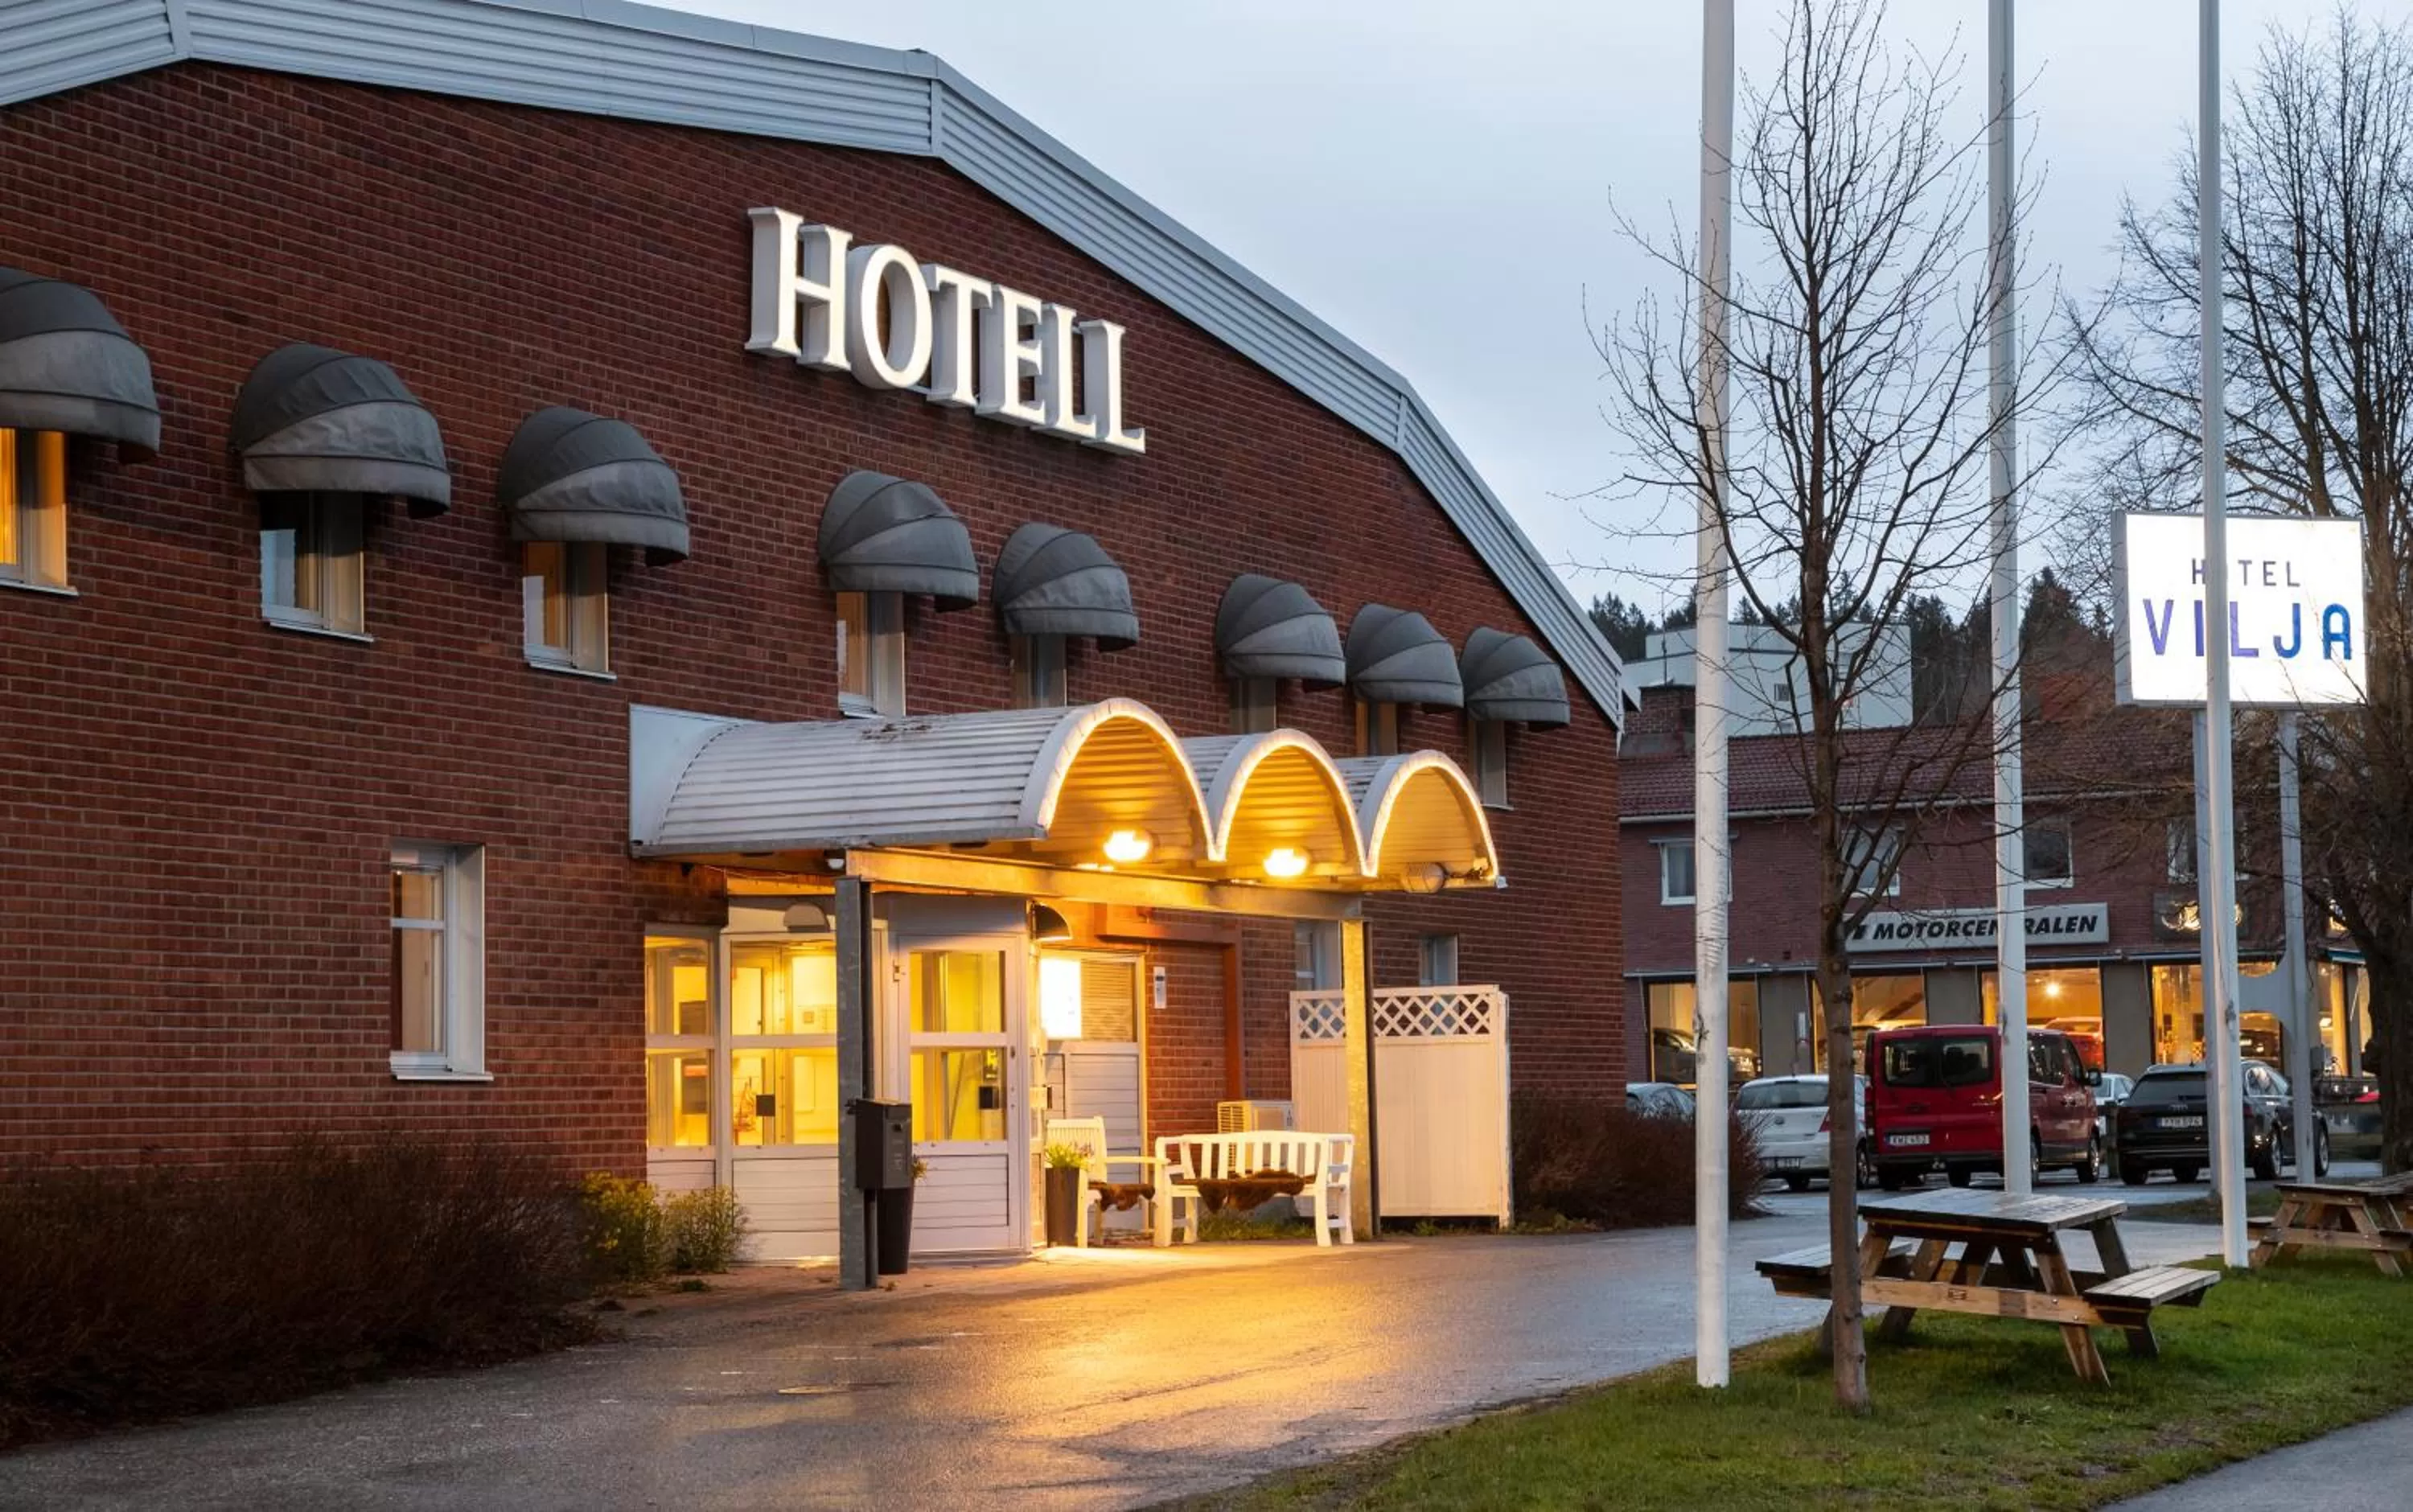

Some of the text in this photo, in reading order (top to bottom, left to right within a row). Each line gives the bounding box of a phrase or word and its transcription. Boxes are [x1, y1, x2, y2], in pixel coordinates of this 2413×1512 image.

[745, 207, 1145, 454] HOTELL
[2192, 558, 2300, 586] HTEL
[2143, 598, 2352, 659] VILJA
[1872, 914, 2097, 939] MOTORCENRALEN
